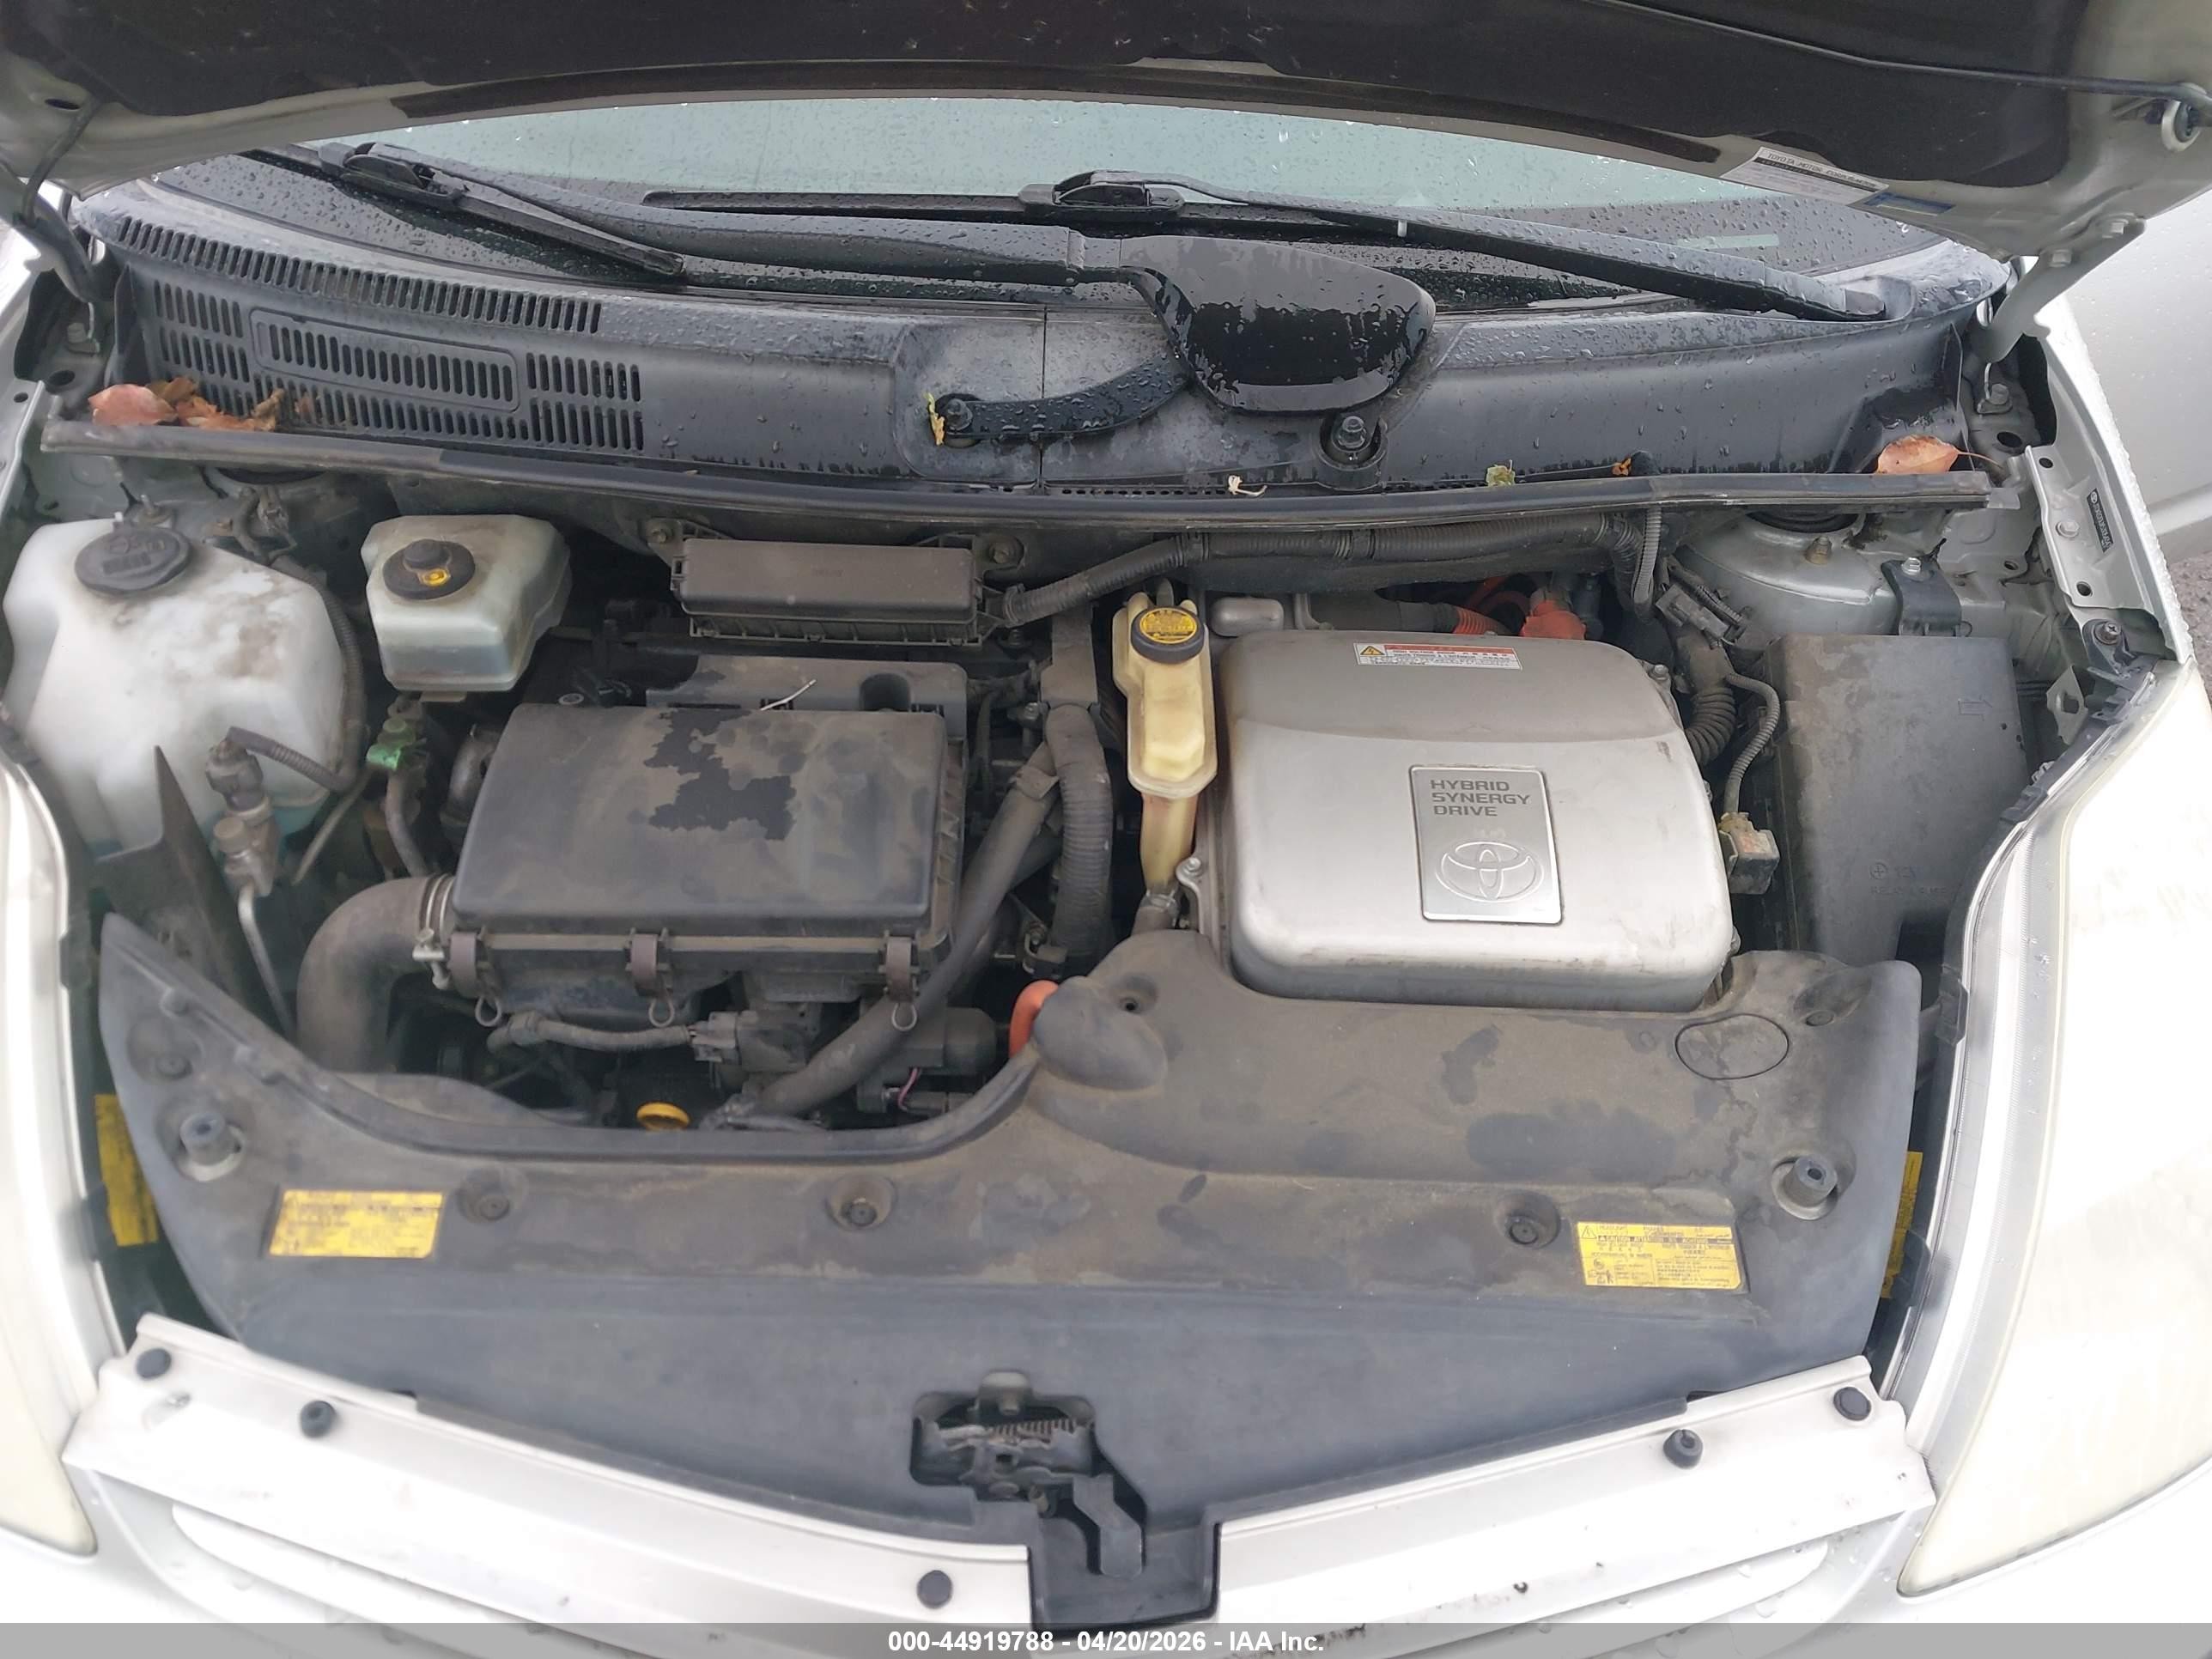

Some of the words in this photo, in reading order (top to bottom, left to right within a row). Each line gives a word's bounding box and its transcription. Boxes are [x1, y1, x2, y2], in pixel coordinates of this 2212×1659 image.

[1767, 153, 1796, 166] TOYOTA
[1431, 780, 1510, 792] HYBRID
[1431, 793, 1530, 805] SYNERGY
[1433, 805, 1498, 817] DRIVE
